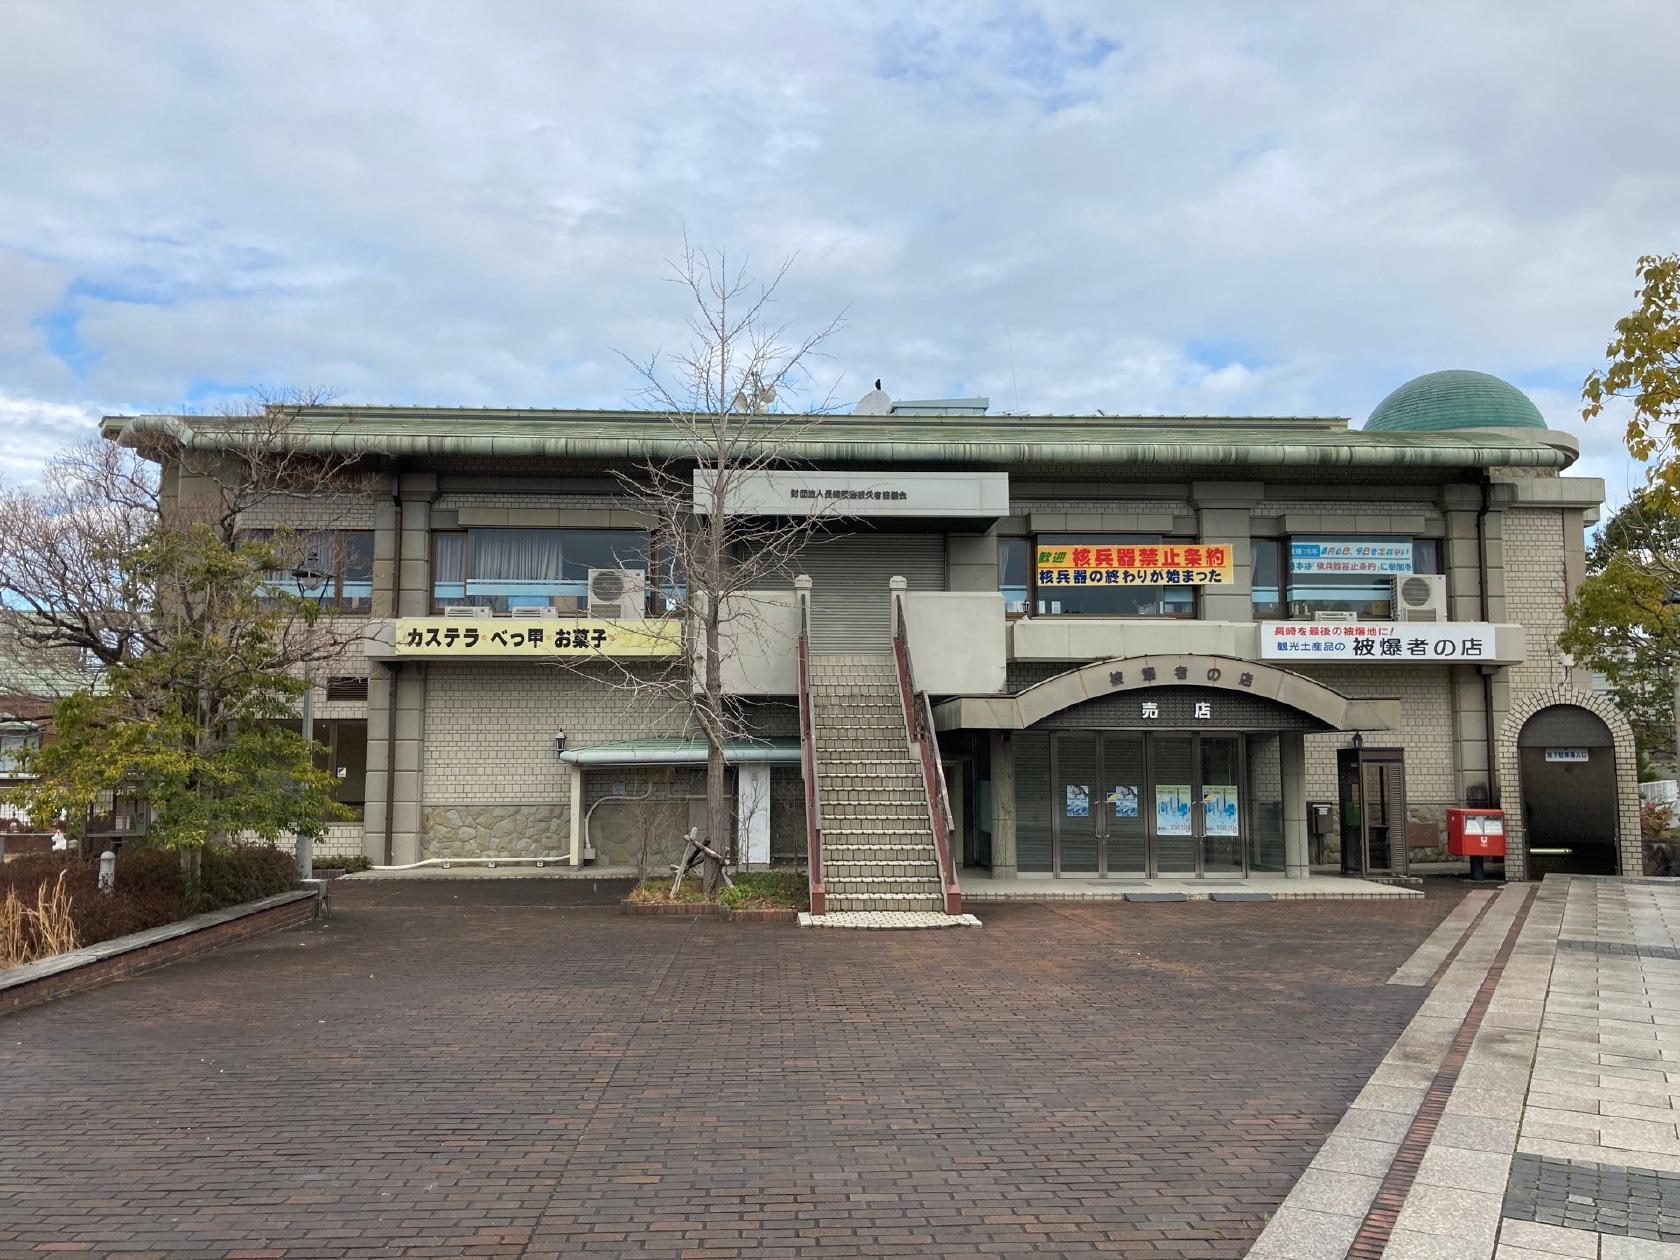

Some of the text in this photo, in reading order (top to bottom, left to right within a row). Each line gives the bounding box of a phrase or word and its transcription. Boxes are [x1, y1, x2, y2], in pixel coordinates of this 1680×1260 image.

[1038, 547, 1225, 568] 歓迎 核兵器禁止条約
[1039, 569, 1222, 585] 核兵器の終わりが始まった
[407, 628, 608, 648] カステラ べっ甲 お菓子
[1277, 637, 1484, 657] 観光土産品の 被爆者の店
[1110, 666, 1253, 687] 被爆者の店
